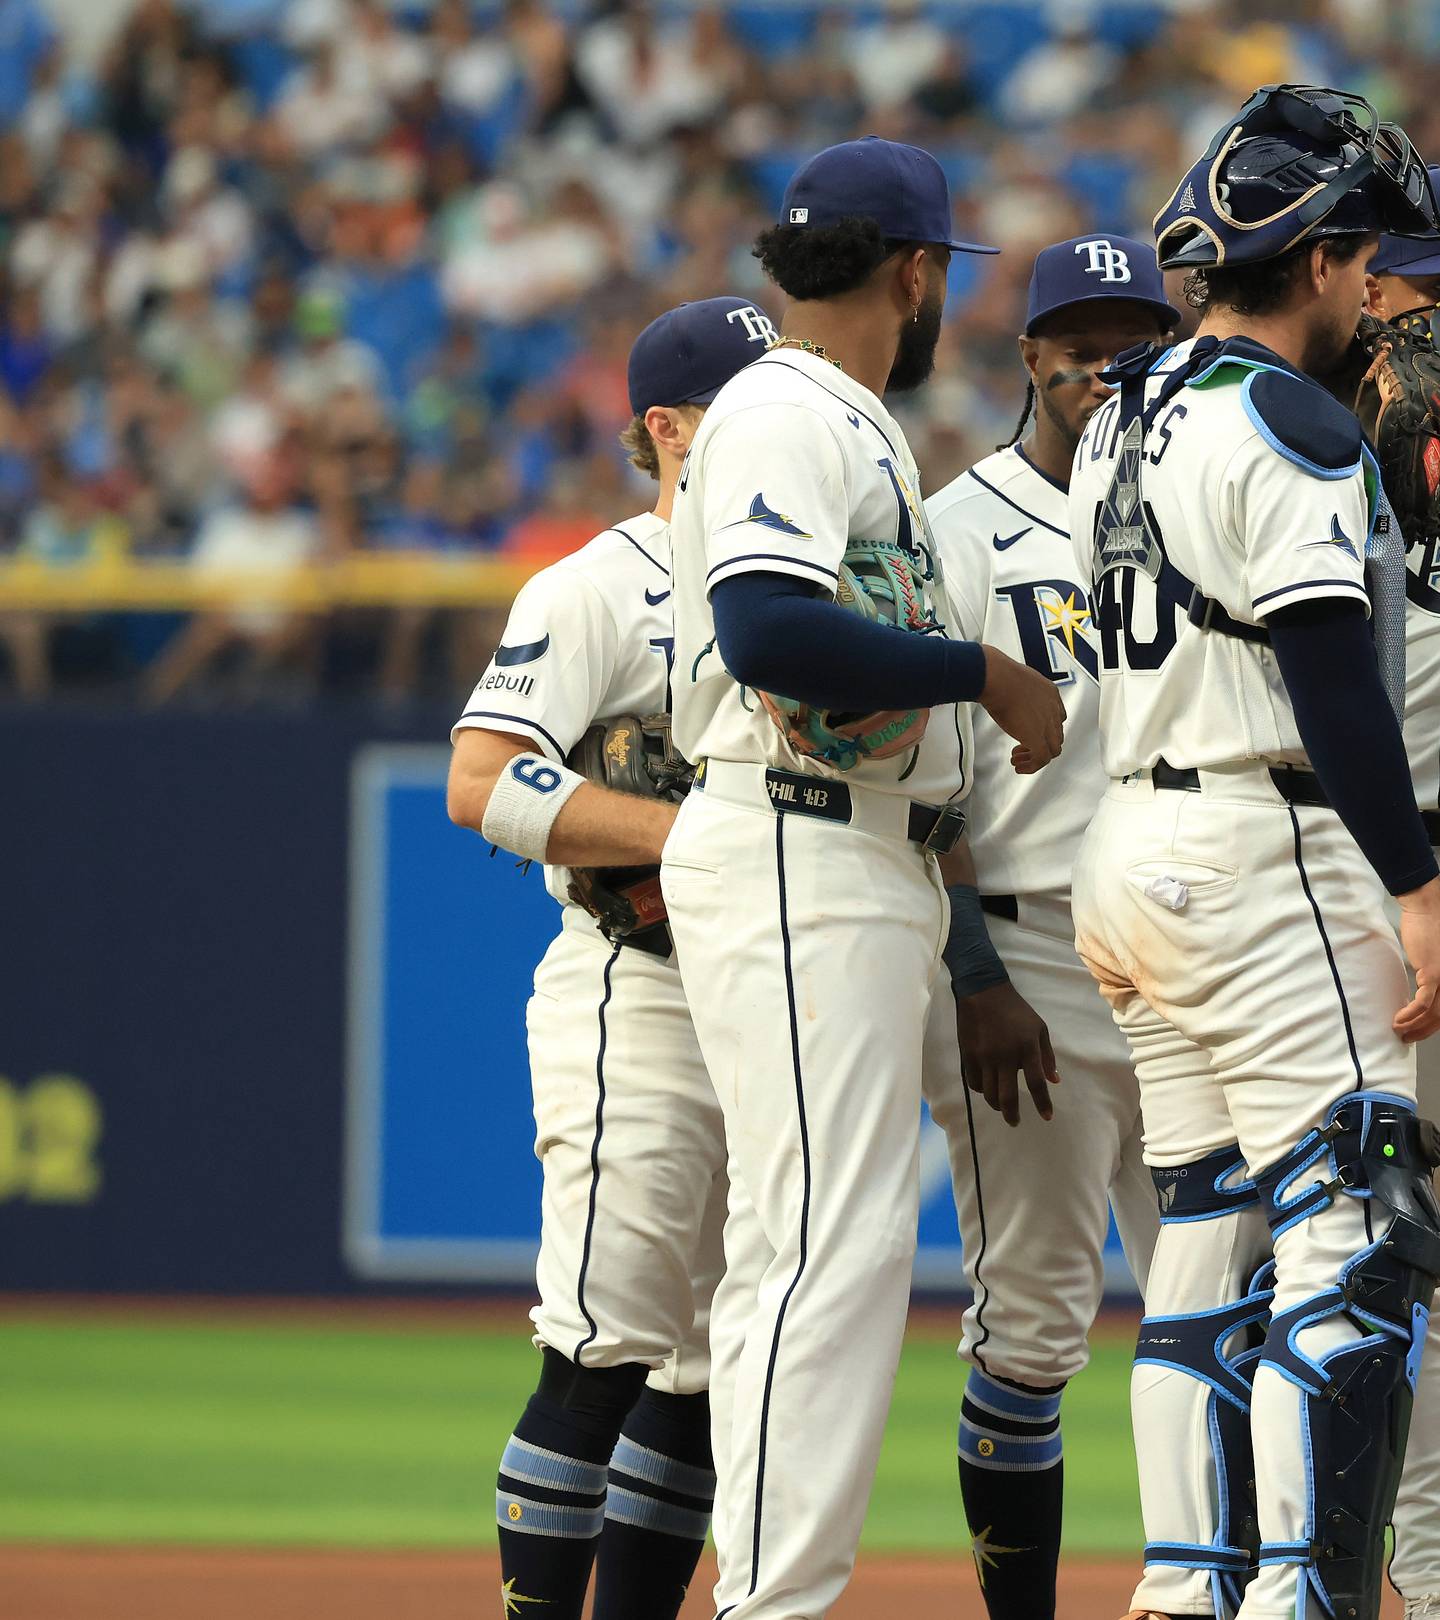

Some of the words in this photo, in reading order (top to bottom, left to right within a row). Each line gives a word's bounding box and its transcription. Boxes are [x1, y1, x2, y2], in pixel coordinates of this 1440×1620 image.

[1074, 240, 1131, 283] TB
[478, 671, 535, 696] ebull
[511, 758, 563, 795] 6
